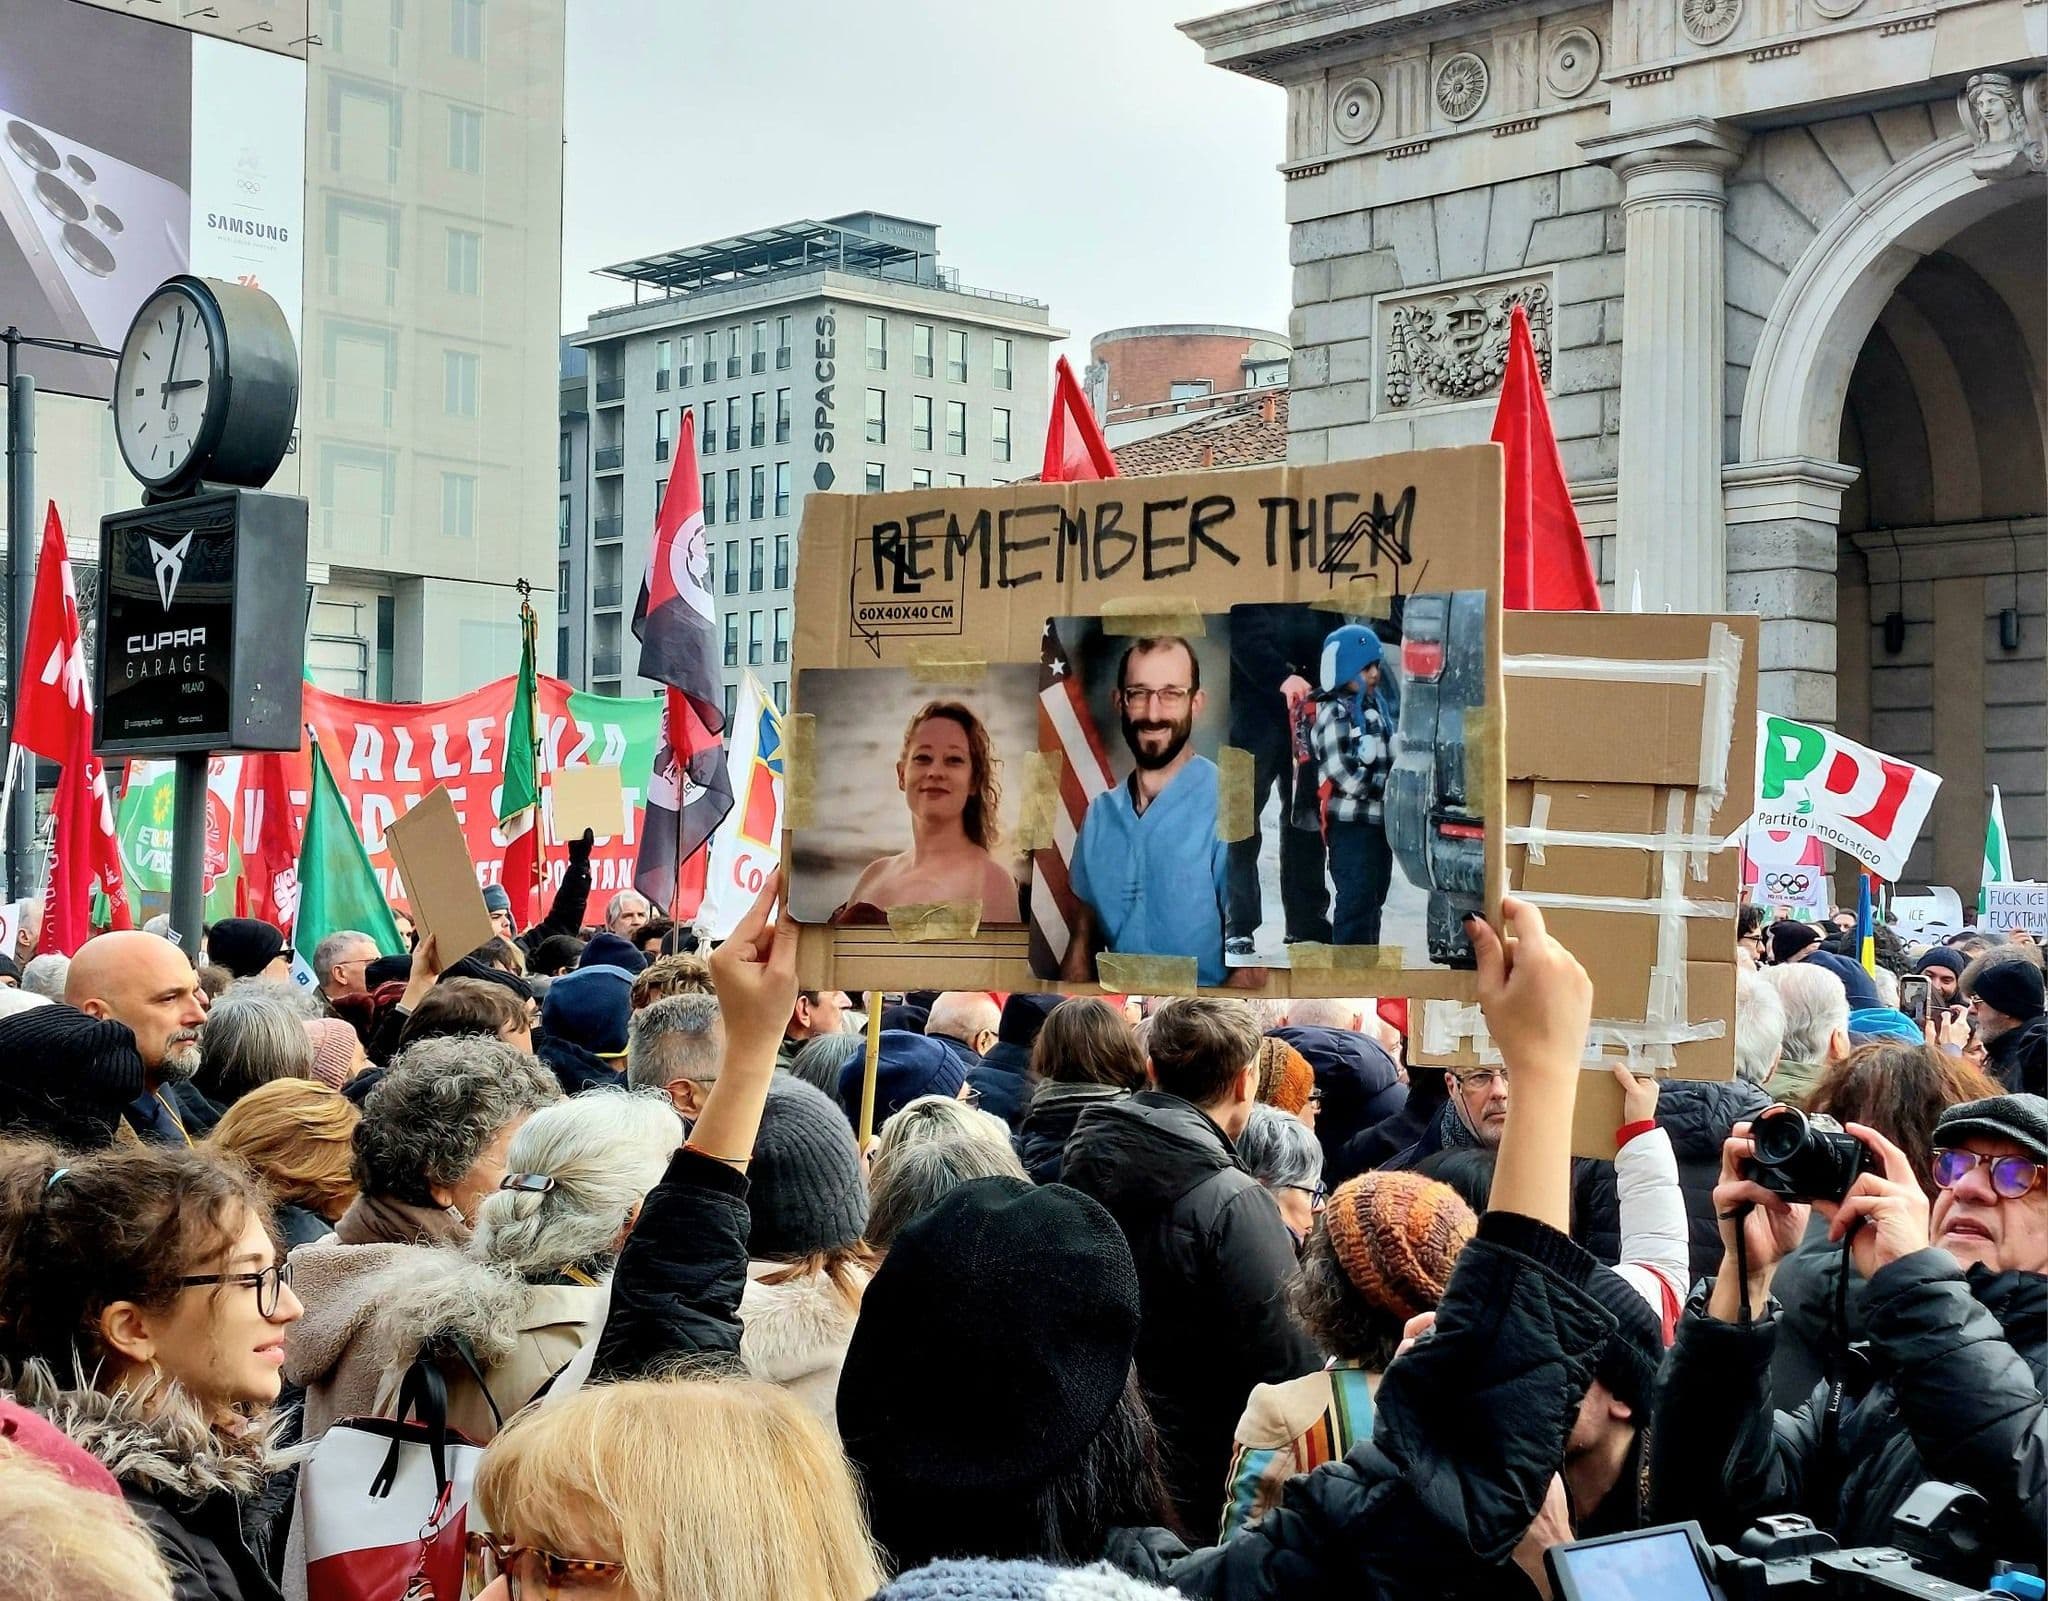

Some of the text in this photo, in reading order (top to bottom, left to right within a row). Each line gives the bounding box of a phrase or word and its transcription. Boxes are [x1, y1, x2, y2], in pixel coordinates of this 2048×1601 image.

[207, 213, 288, 242] SAMSUNG
[872, 486, 1416, 591] REMEMBER THEM
[859, 605, 954, 620] 60X40X40 CM
[127, 627, 206, 654] CUPRA
[126, 653, 206, 679] GARAGE
[181, 681, 205, 693] MILANO
[349, 713, 627, 783] ALLENZA
[1758, 812, 1808, 829] Partito
[1991, 890, 2045, 906] FUCK ICE
[1909, 909, 1925, 921] ICE
[1829, 1381, 1842, 1412] LUMIX
